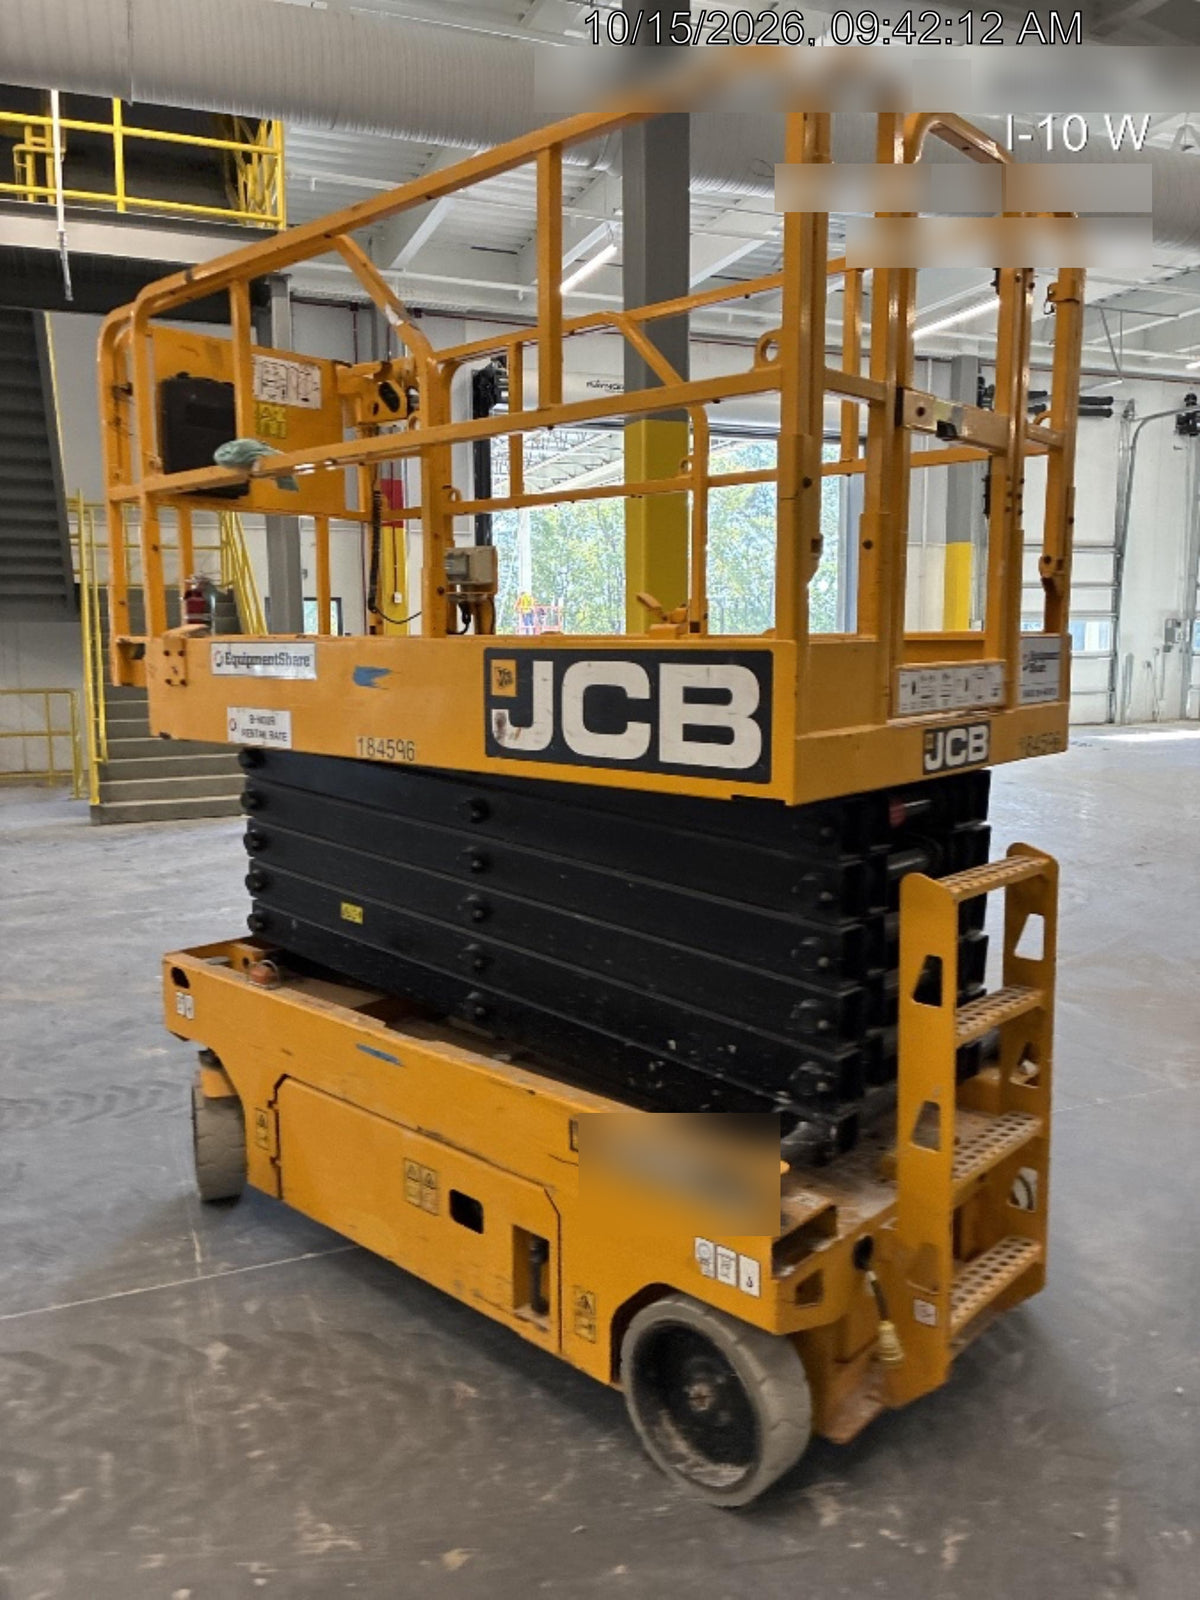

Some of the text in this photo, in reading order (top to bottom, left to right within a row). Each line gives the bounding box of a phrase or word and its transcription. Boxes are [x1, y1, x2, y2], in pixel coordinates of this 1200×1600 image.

[224, 650, 311, 669] EquipmentShare
[491, 659, 763, 770] JCB
[358, 736, 415, 762] 184596
[923, 724, 991, 772] JCB
